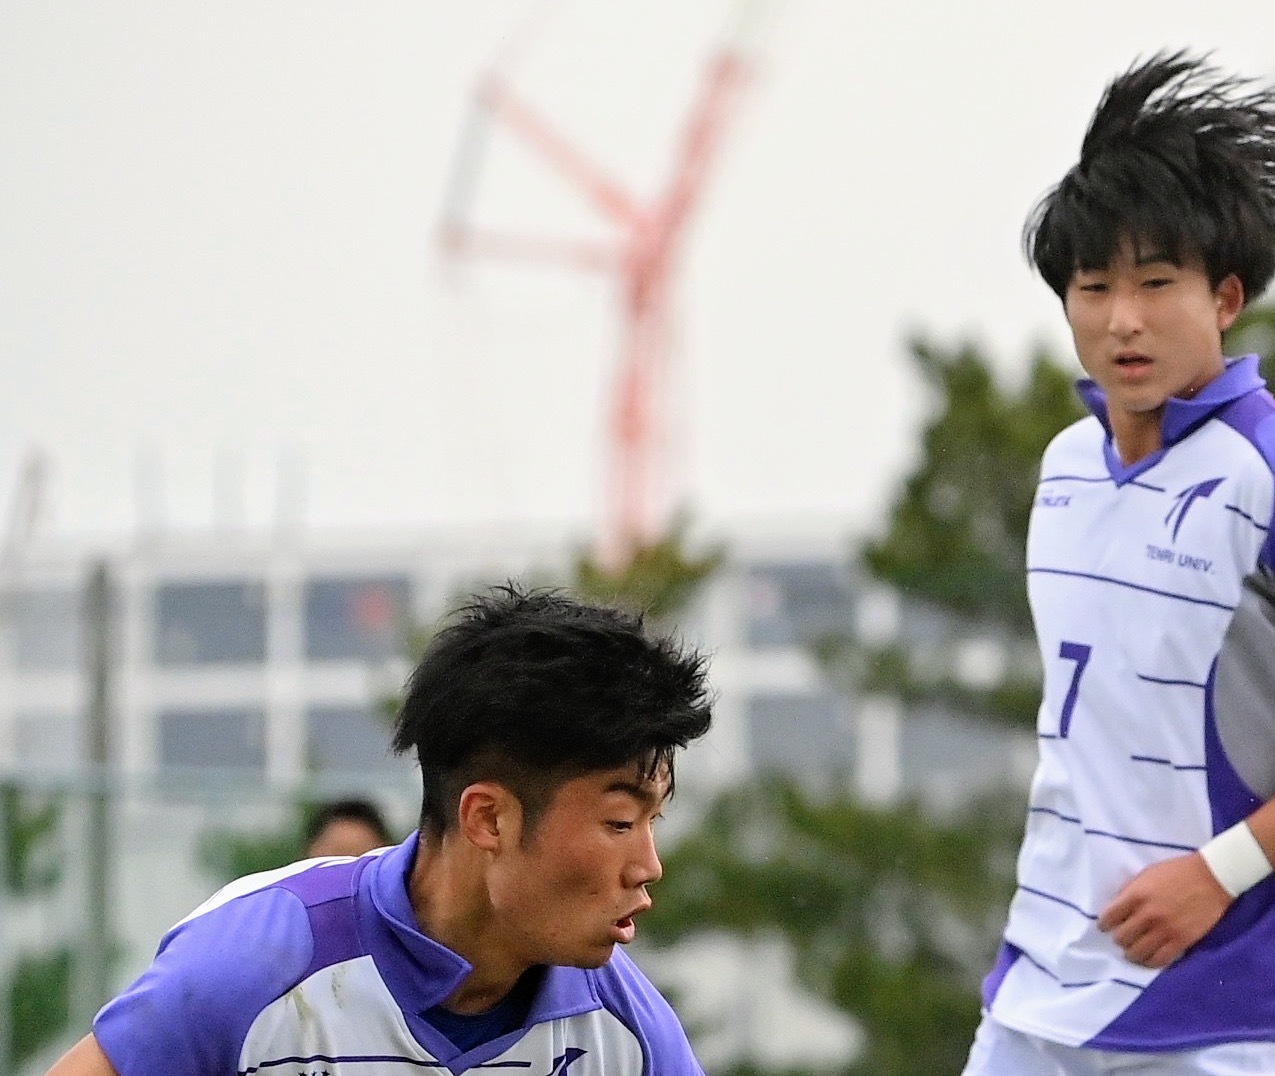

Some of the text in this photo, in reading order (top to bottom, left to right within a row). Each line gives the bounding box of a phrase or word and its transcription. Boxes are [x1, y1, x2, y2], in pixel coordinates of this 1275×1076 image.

[1145, 543, 1215, 575] TENRI UNIV.
[1059, 641, 1092, 739] 7
